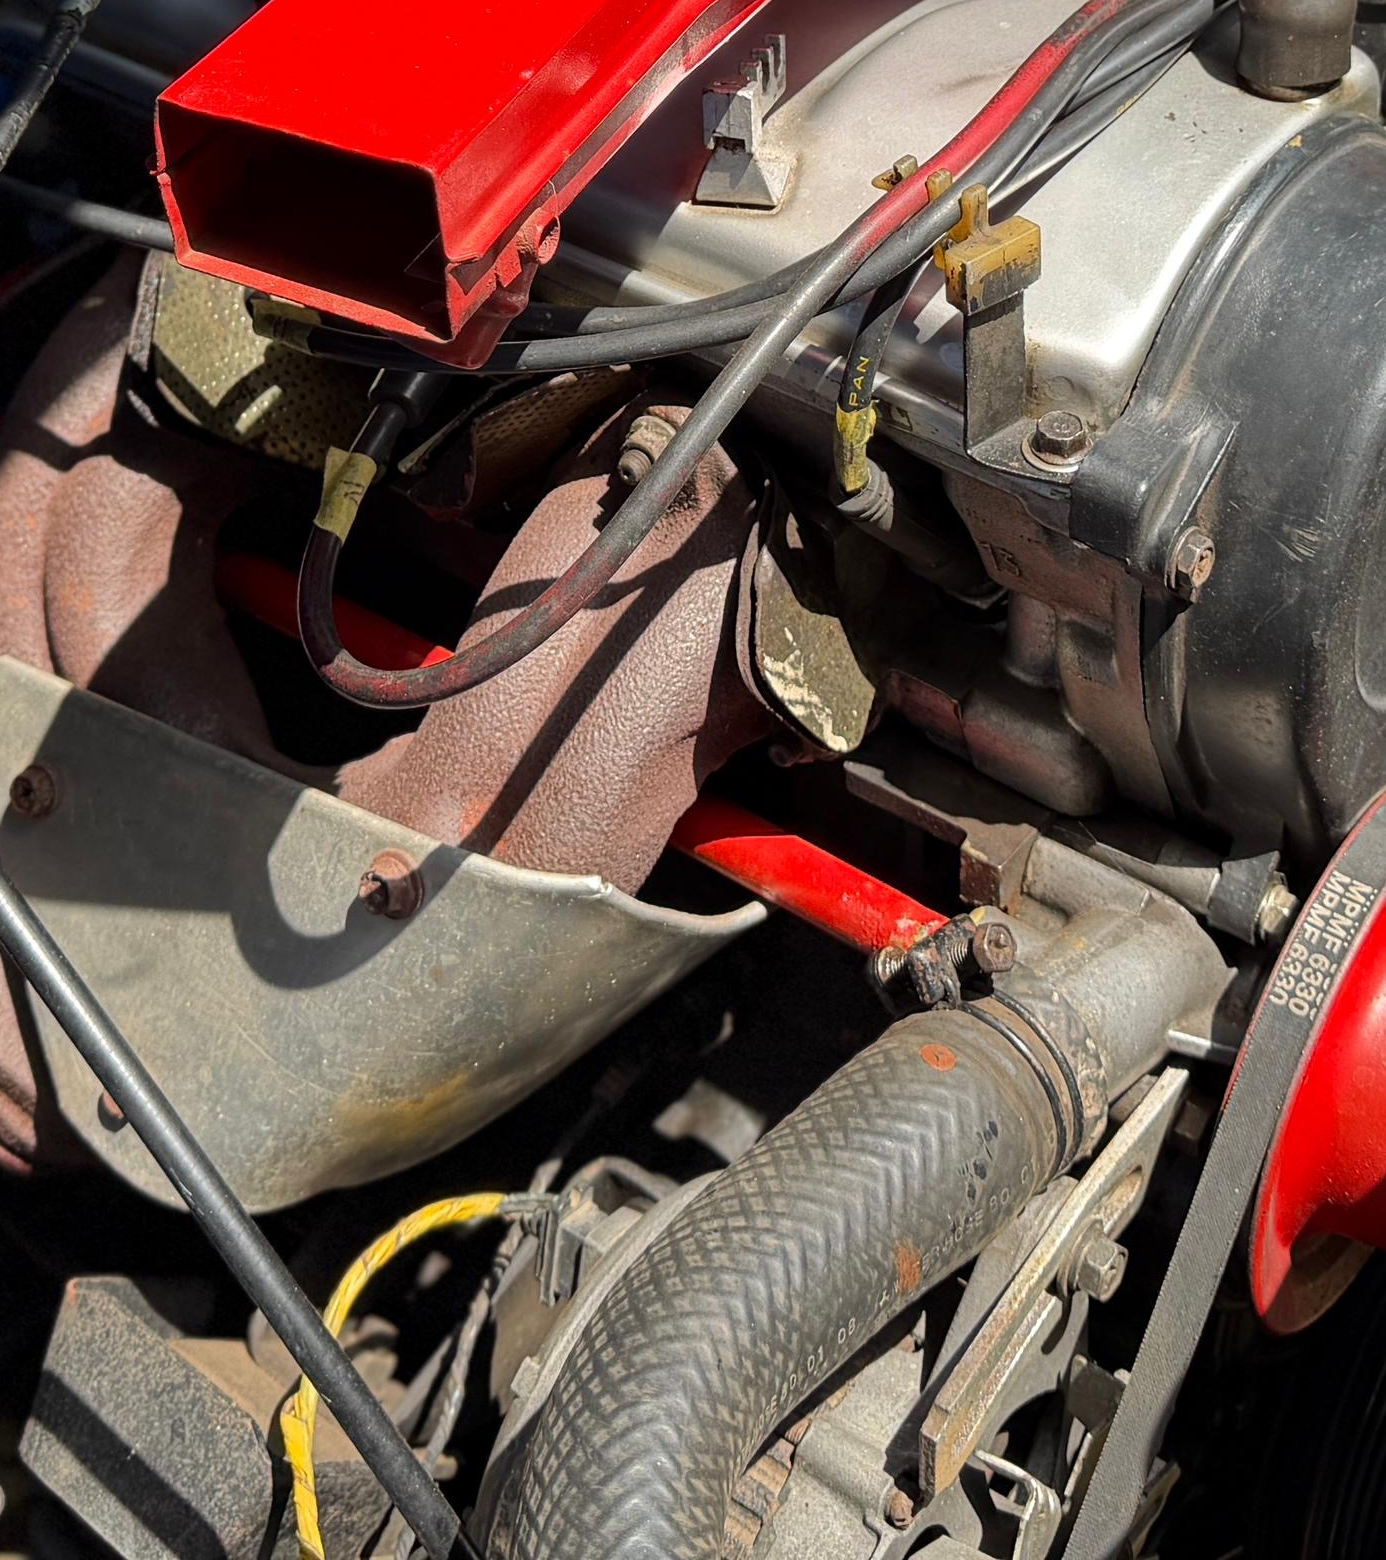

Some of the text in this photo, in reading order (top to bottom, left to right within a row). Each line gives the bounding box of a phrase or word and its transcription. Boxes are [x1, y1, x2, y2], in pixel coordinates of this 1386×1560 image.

[1303, 870, 1351, 945] MPMF
[1322, 879, 1374, 954] MPMF
[1288, 952, 1331, 1017] 6330
[807, 1344, 824, 1372] 01
[837, 1317, 856, 1344] 08
